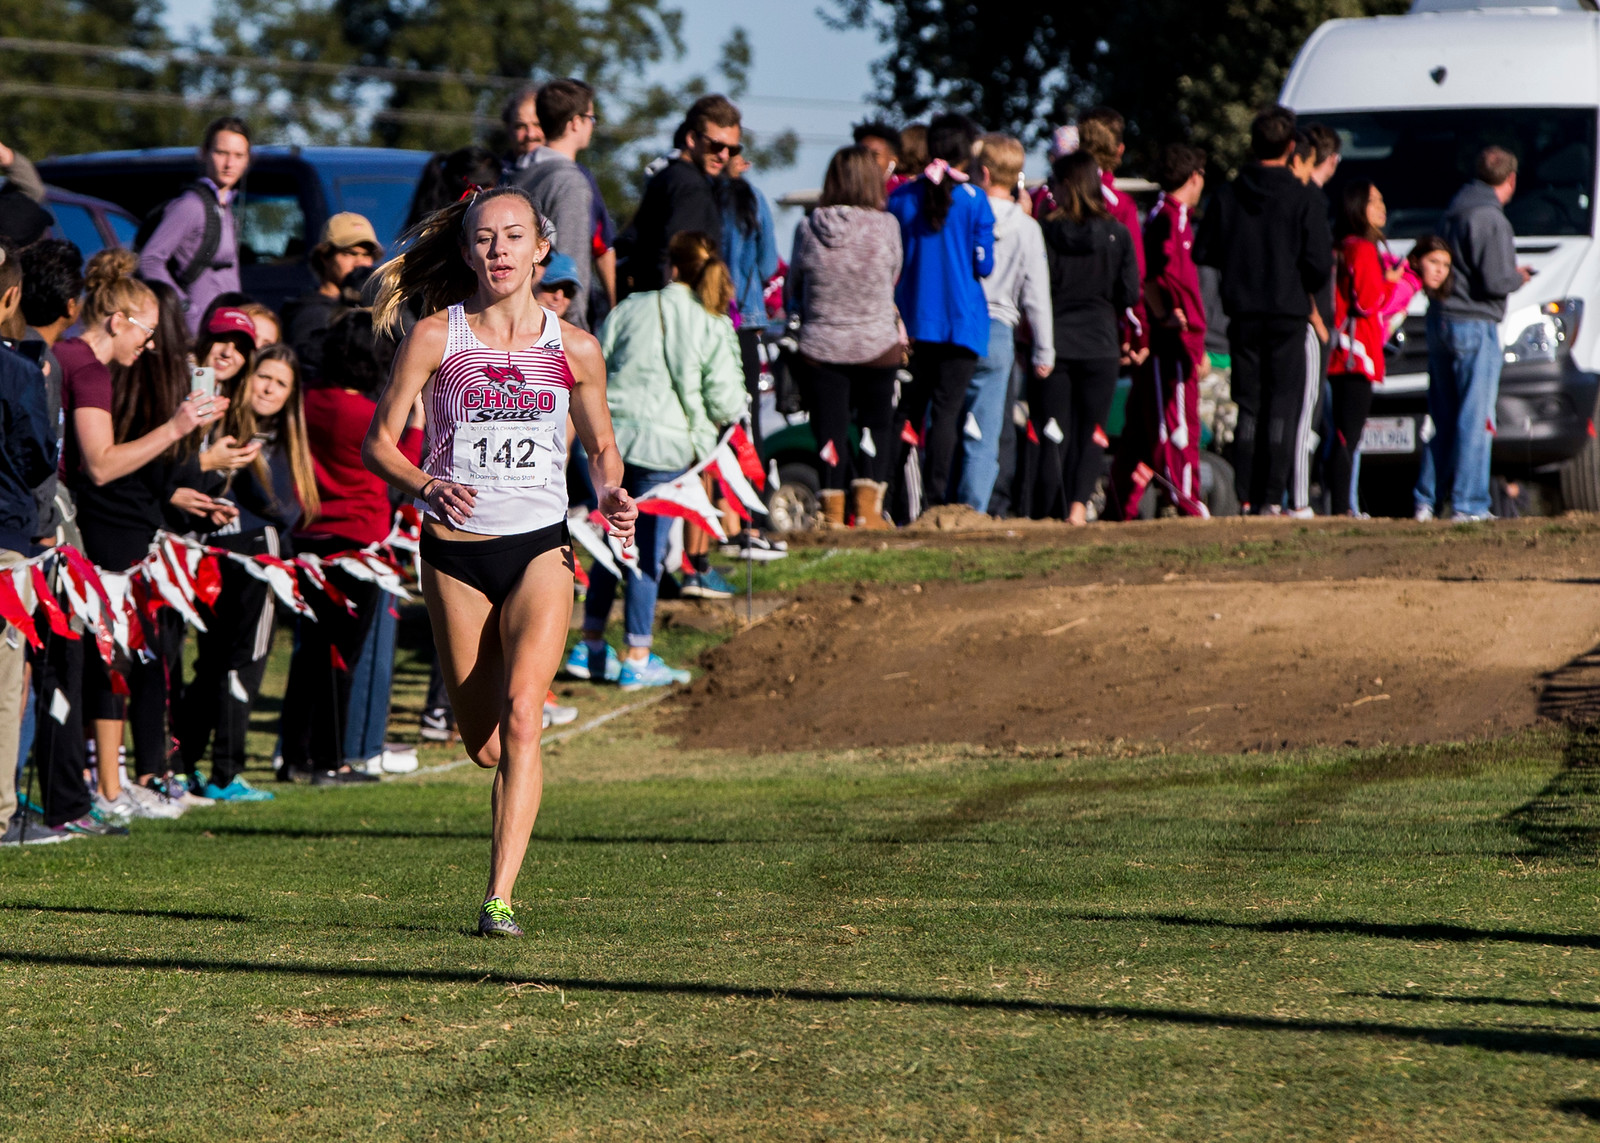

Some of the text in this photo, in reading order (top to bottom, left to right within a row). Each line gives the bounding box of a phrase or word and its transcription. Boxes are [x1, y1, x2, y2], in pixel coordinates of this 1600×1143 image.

[462, 387, 556, 413] CHICO
[471, 409, 541, 422] State
[473, 437, 536, 469] 142
